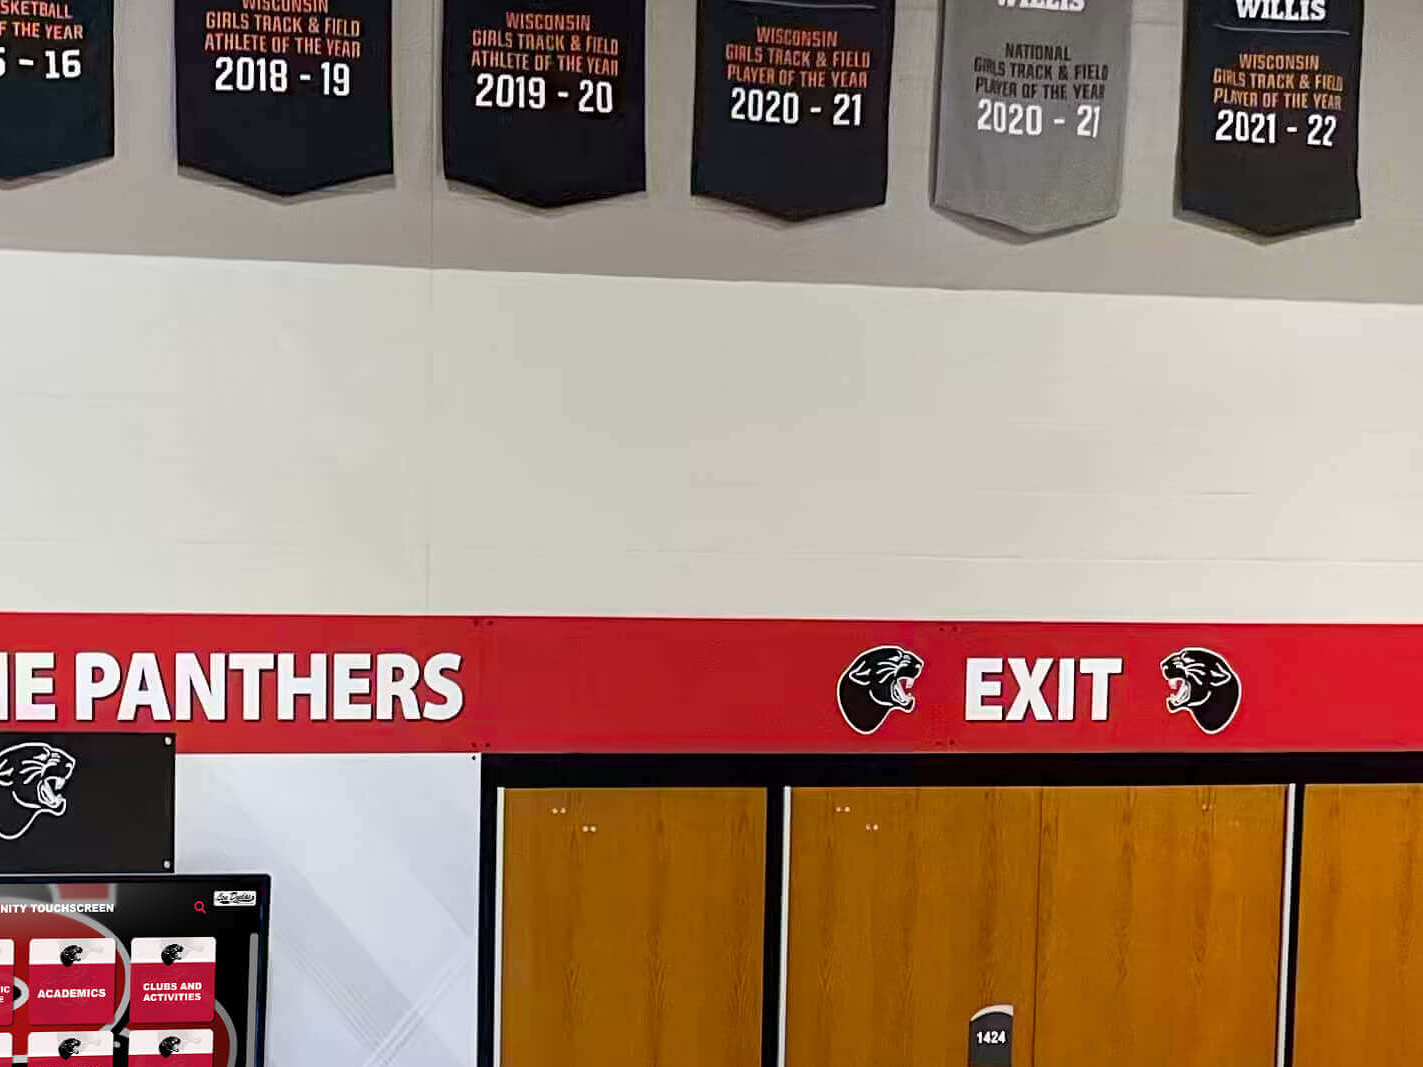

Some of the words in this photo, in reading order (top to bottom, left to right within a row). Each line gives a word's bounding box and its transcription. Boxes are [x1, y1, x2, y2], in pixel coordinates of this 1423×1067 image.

[243, 0, 328, 14] WISCONSIN
[1236, 0, 1326, 21] WILLIS
[12, 21, 40, 38] THE
[45, 24, 83, 40] YEAR
[206, 11, 249, 30] GIRLS
[254, 14, 303, 33] TRACK
[309, 17, 320, 34] &
[325, 18, 360, 37] FIELD
[505, 12, 591, 31] WISCONSIN
[205, 33, 267, 53] ATHLETE
[272, 36, 289, 54] OF
[294, 37, 321, 55] THE
[327, 38, 361, 58] YEAR
[472, 29, 513, 48] GIRLS
[518, 33, 565, 51] TRACK
[571, 35, 581, 51] &
[586, 36, 618, 56] FIELD
[757, 26, 838, 47] WISCONSIN
[471, 50, 529, 70] ATHLETE
[535, 54, 551, 71] OF
[557, 55, 582, 72] THE
[587, 56, 618, 76] YEAR
[725, 44, 763, 63] GIRLS
[768, 48, 810, 67] TRACK
[816, 51, 827, 67] &
[833, 52, 870, 68] FIELD
[1005, 42, 1071, 61] NATIONAL
[1239, 54, 1319, 71] WISCONSIN
[19, 58, 34, 66] -
[45, 50, 81, 79] 16
[215, 56, 287, 92] 2018
[321, 62, 349, 96] 19
[727, 64, 774, 85] PLAYER
[779, 70, 797, 86] OF
[801, 70, 826, 88] THE
[831, 72, 867, 88] YEAR
[974, 56, 1005, 76] GIRLS
[1009, 62, 1053, 80] TRACK
[1058, 64, 1068, 80] &
[1075, 64, 1109, 80] FIELD
[976, 77, 1017, 98] PLAYER
[1022, 84, 1038, 99] OF
[1042, 84, 1067, 100] THE
[1073, 84, 1105, 100] YEAR
[1213, 68, 1245, 87] GIRLS
[1249, 73, 1295, 89] TRACK
[1299, 74, 1310, 89] &
[1315, 74, 1343, 92] FIELD
[475, 73, 545, 109] 2019
[579, 80, 613, 113] 20
[1214, 88, 1257, 107] PLAYER
[1263, 92, 1278, 108] OF
[1283, 93, 1308, 108] THE
[1313, 94, 1341, 111] YEAR
[731, 87, 799, 124] 2020
[833, 94, 862, 126] 21
[977, 98, 1042, 136] 2020
[1077, 104, 1100, 138] 21
[1215, 109, 1276, 144] 2021
[1308, 114, 1337, 146] 22
[76, 651, 463, 722] PANTHERS
[965, 657, 1122, 720] EXIT
[30, 904, 115, 912] TOUCHSCREEN
[37, 989, 106, 999] ACADEMICS
[143, 982, 177, 991] CLUBS
[180, 982, 202, 991] AND
[143, 993, 201, 1002] ACTIVITIES
[977, 1030, 1006, 1044] 1424
